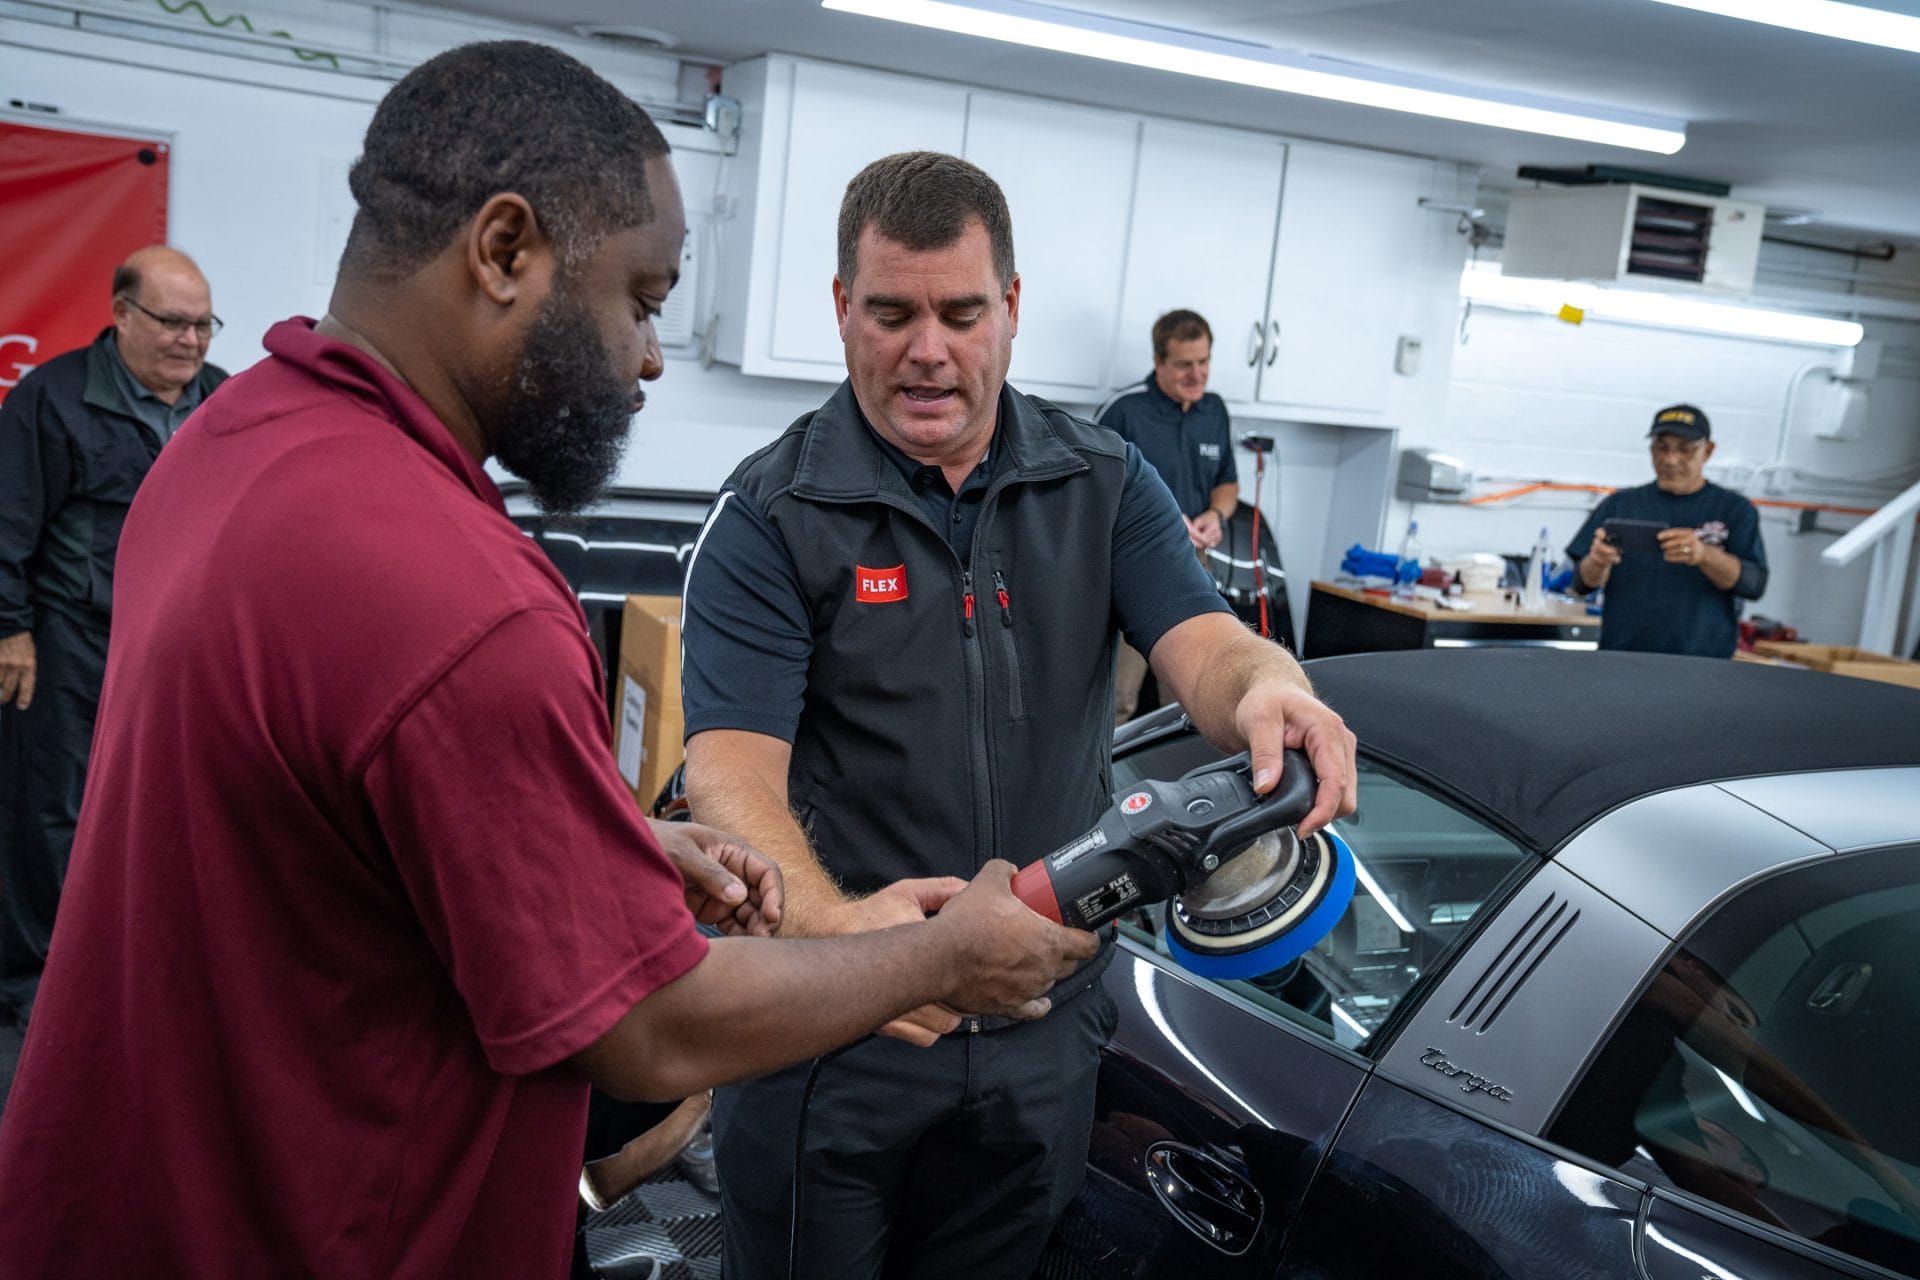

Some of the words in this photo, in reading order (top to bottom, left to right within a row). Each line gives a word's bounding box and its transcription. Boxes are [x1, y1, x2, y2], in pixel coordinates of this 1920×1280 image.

[862, 577, 898, 593] FLEX
[1109, 873, 1130, 889] FLEX
[1420, 1046, 1513, 1101] Targa
